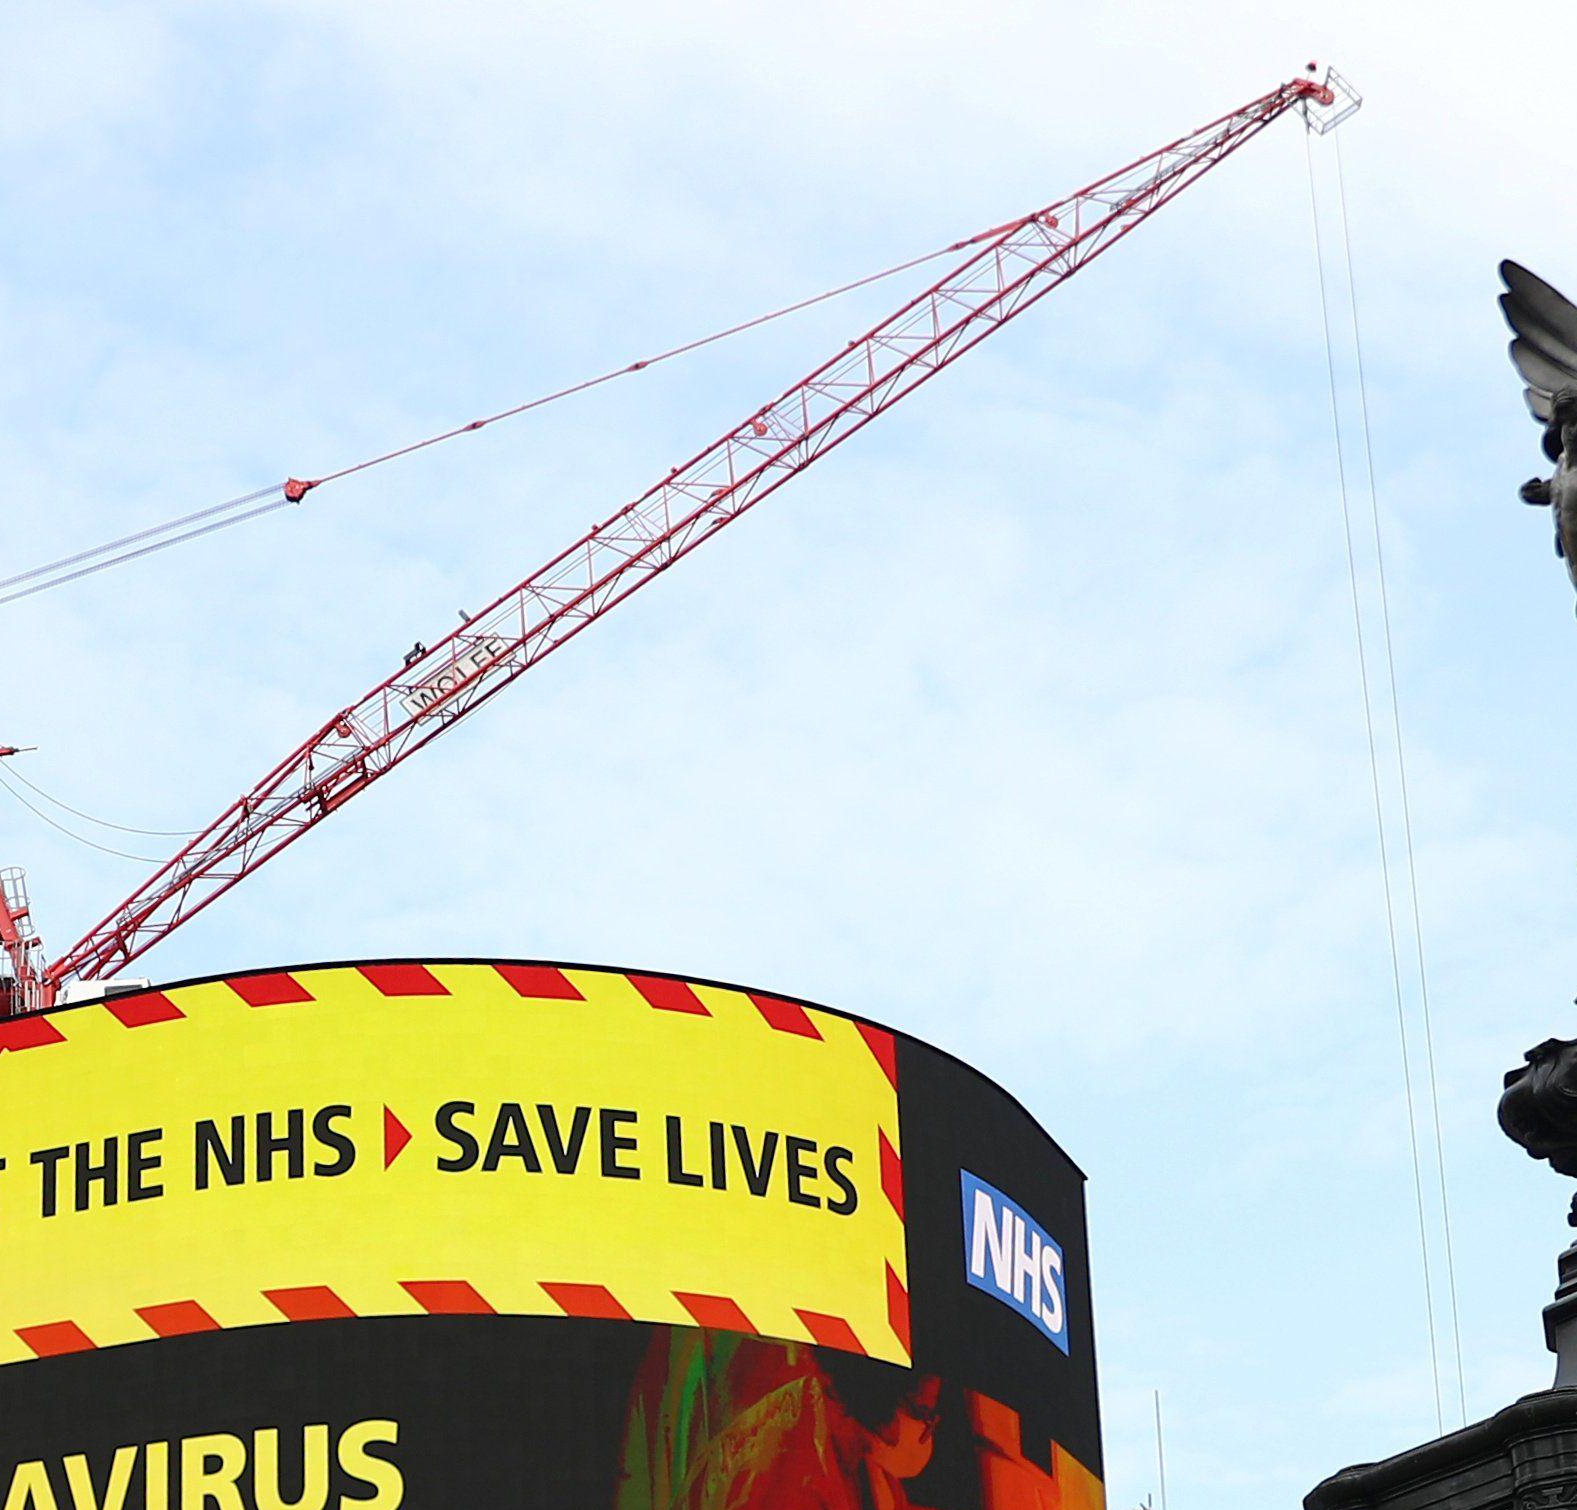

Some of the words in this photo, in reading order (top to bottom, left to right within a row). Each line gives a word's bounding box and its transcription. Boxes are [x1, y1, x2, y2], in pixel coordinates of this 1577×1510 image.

[30, 1128, 164, 1218] THE
[194, 1104, 356, 1191] NHS
[435, 1100, 639, 1180] SAVE
[666, 1124, 858, 1216] LIVES
[970, 1188, 1063, 1335] NHS
